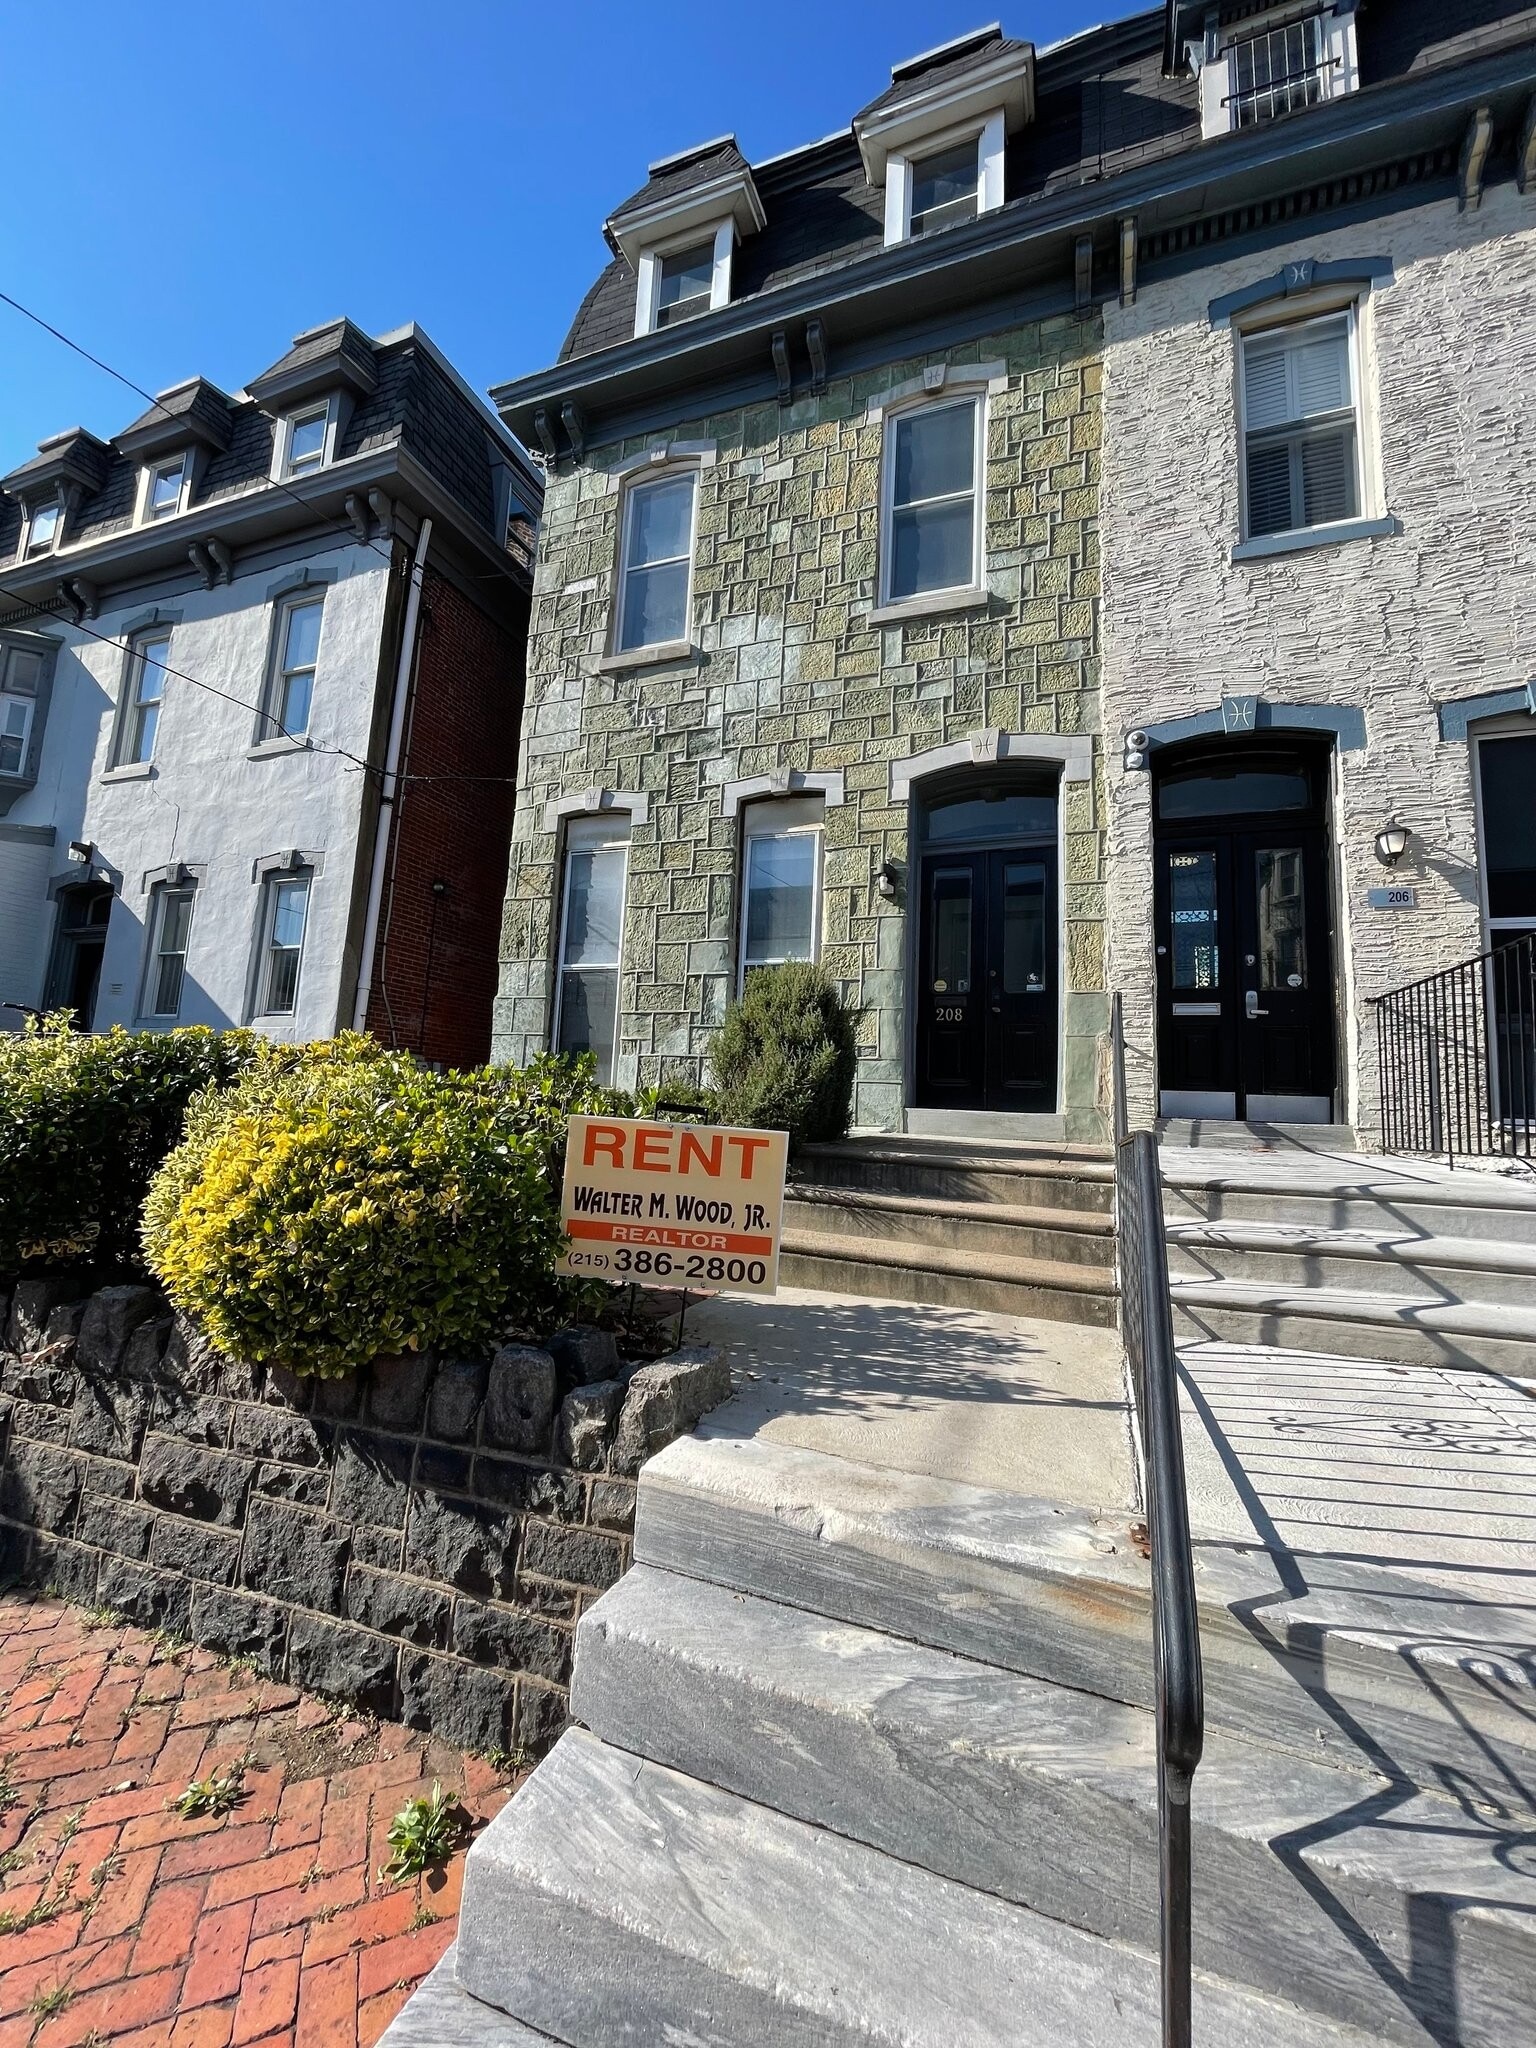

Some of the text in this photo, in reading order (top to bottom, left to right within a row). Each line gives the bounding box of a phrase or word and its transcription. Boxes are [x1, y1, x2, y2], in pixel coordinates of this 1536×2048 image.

[1388, 891, 1409, 902] 206
[936, 1008, 963, 1022] 208
[583, 1124, 770, 1180] RENT
[573, 1186, 771, 1232] WALTER M. WOOD, JR.
[611, 1226, 727, 1249] REALTOR
[567, 1248, 766, 1285] (215) 386-2800
